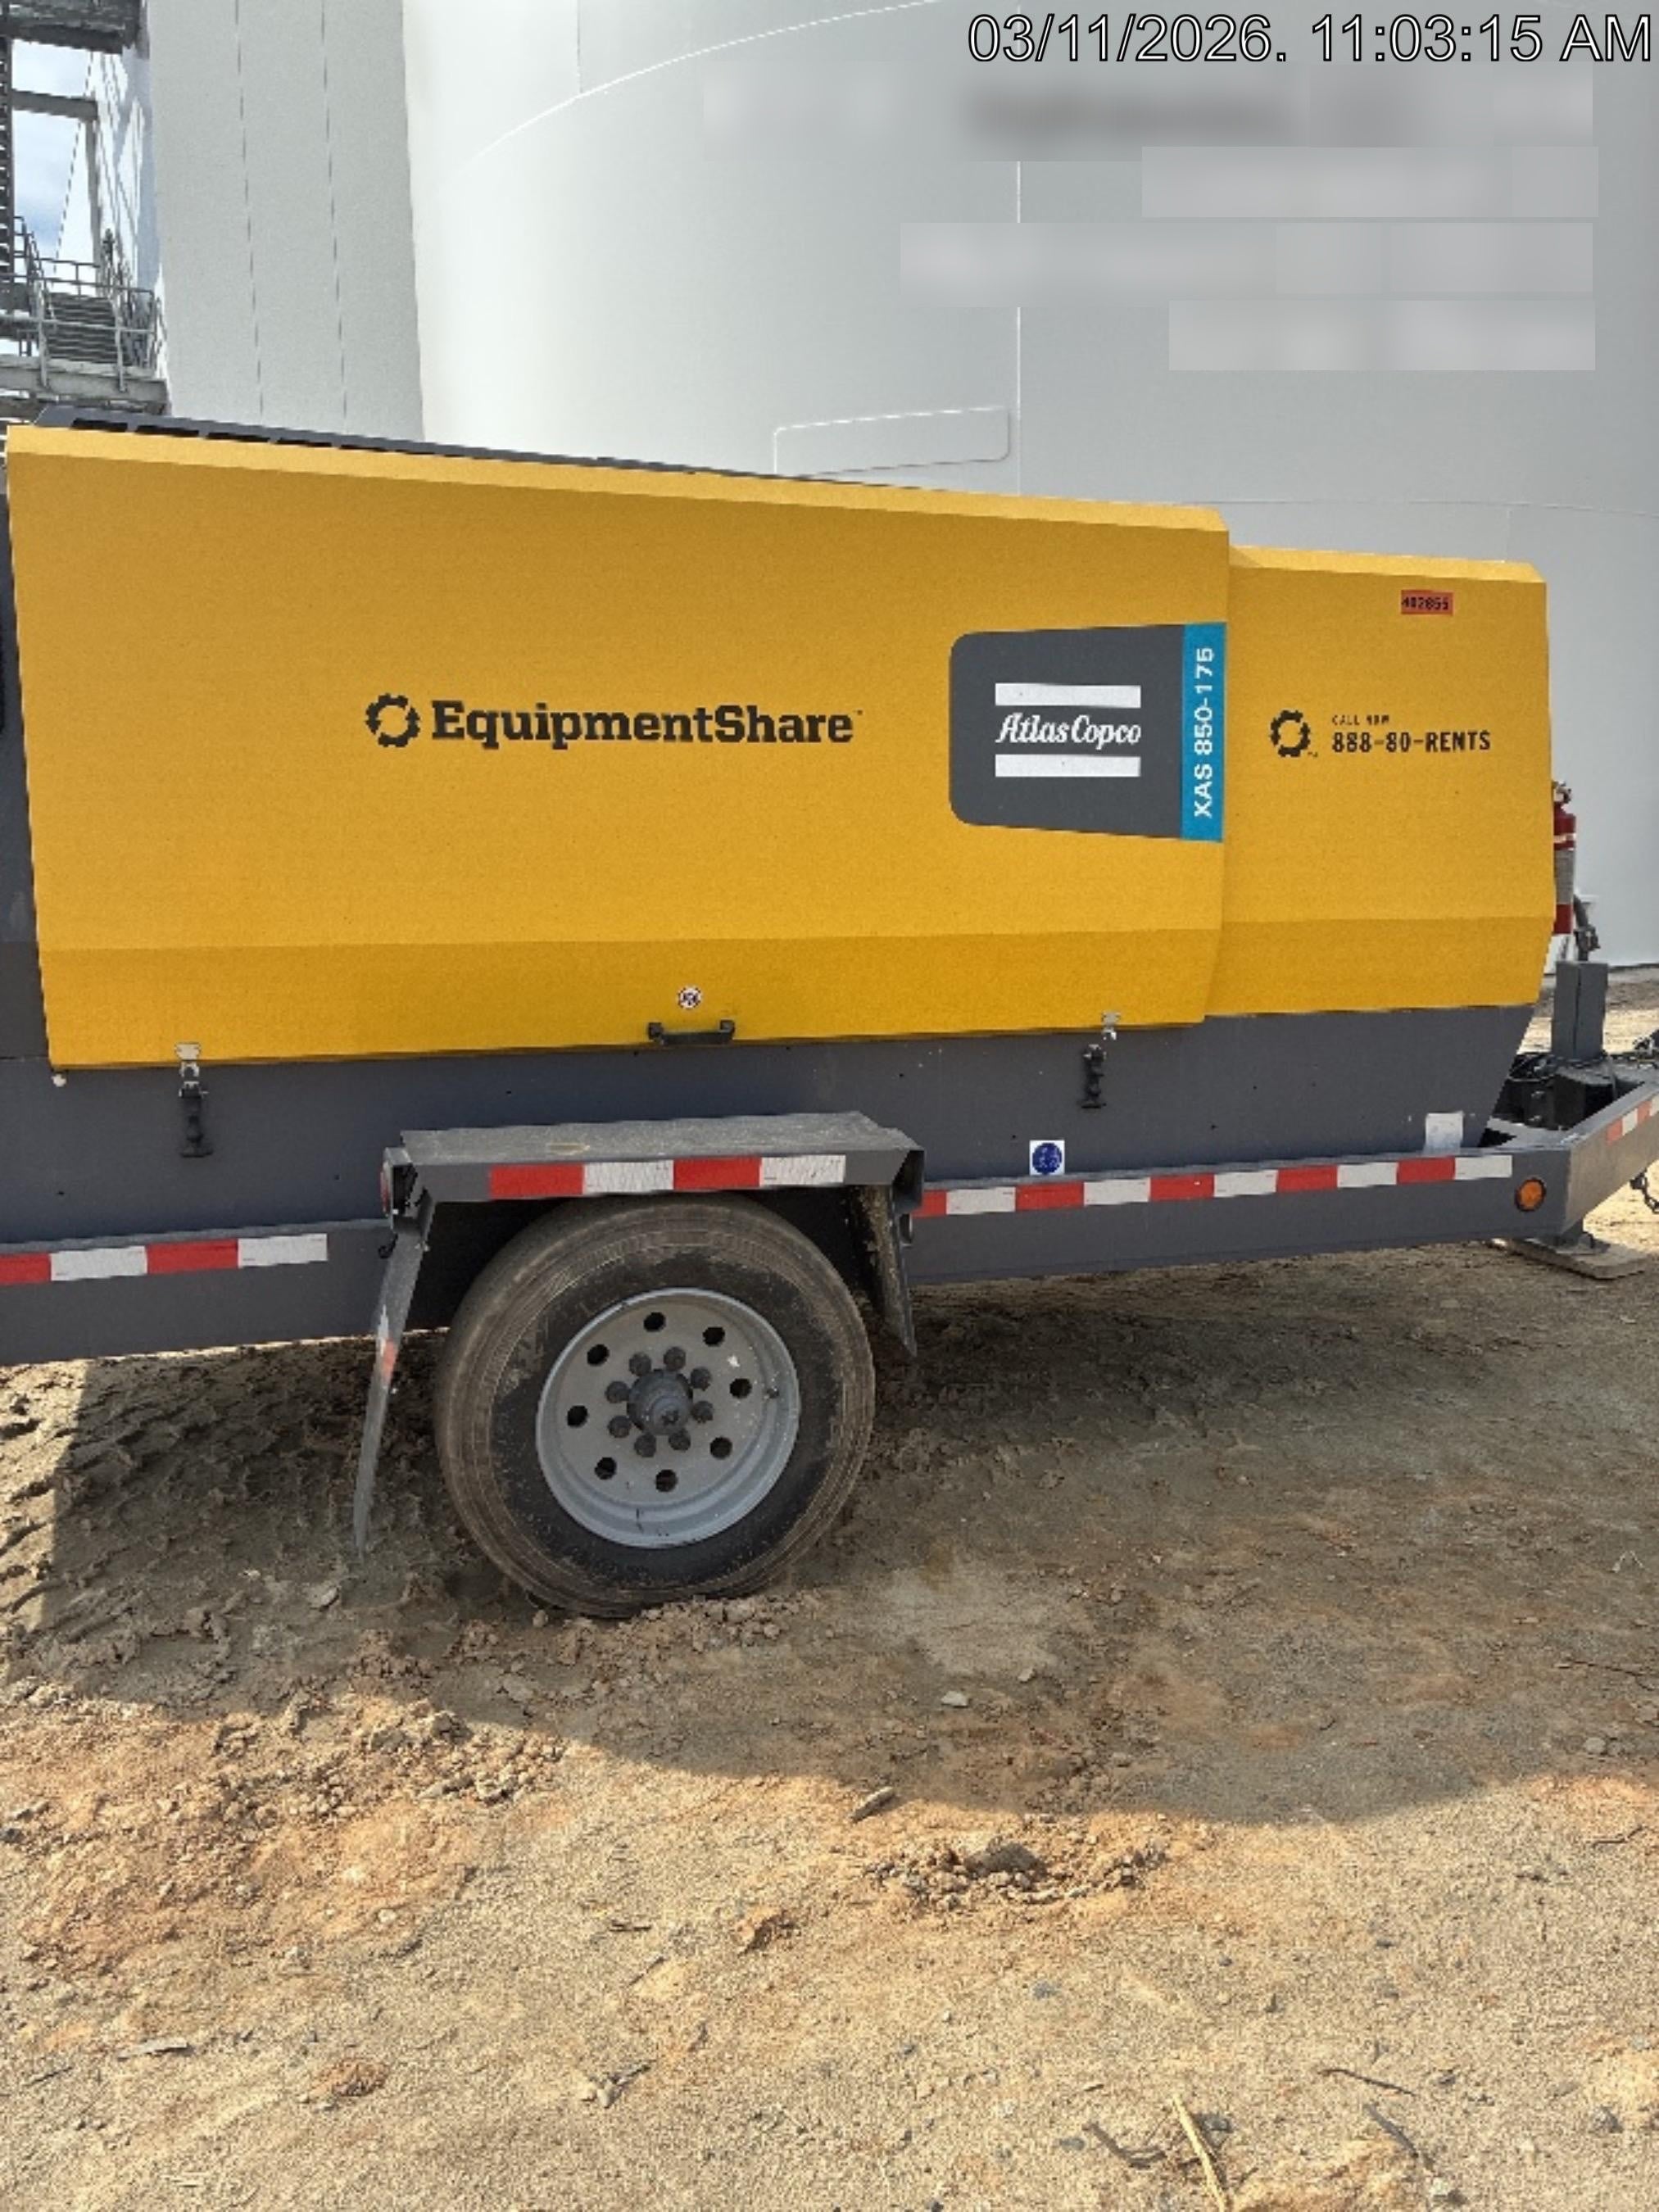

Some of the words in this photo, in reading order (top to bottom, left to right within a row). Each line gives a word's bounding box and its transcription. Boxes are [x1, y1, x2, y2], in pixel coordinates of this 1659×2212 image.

[431, 700, 852, 749] EquipmentShare
[1194, 647, 1214, 755] 850-175
[1332, 715, 1360, 726] CALL
[995, 712, 1069, 743] Atlas
[1071, 714, 1141, 750] Copco
[1194, 764, 1214, 818] XAS
